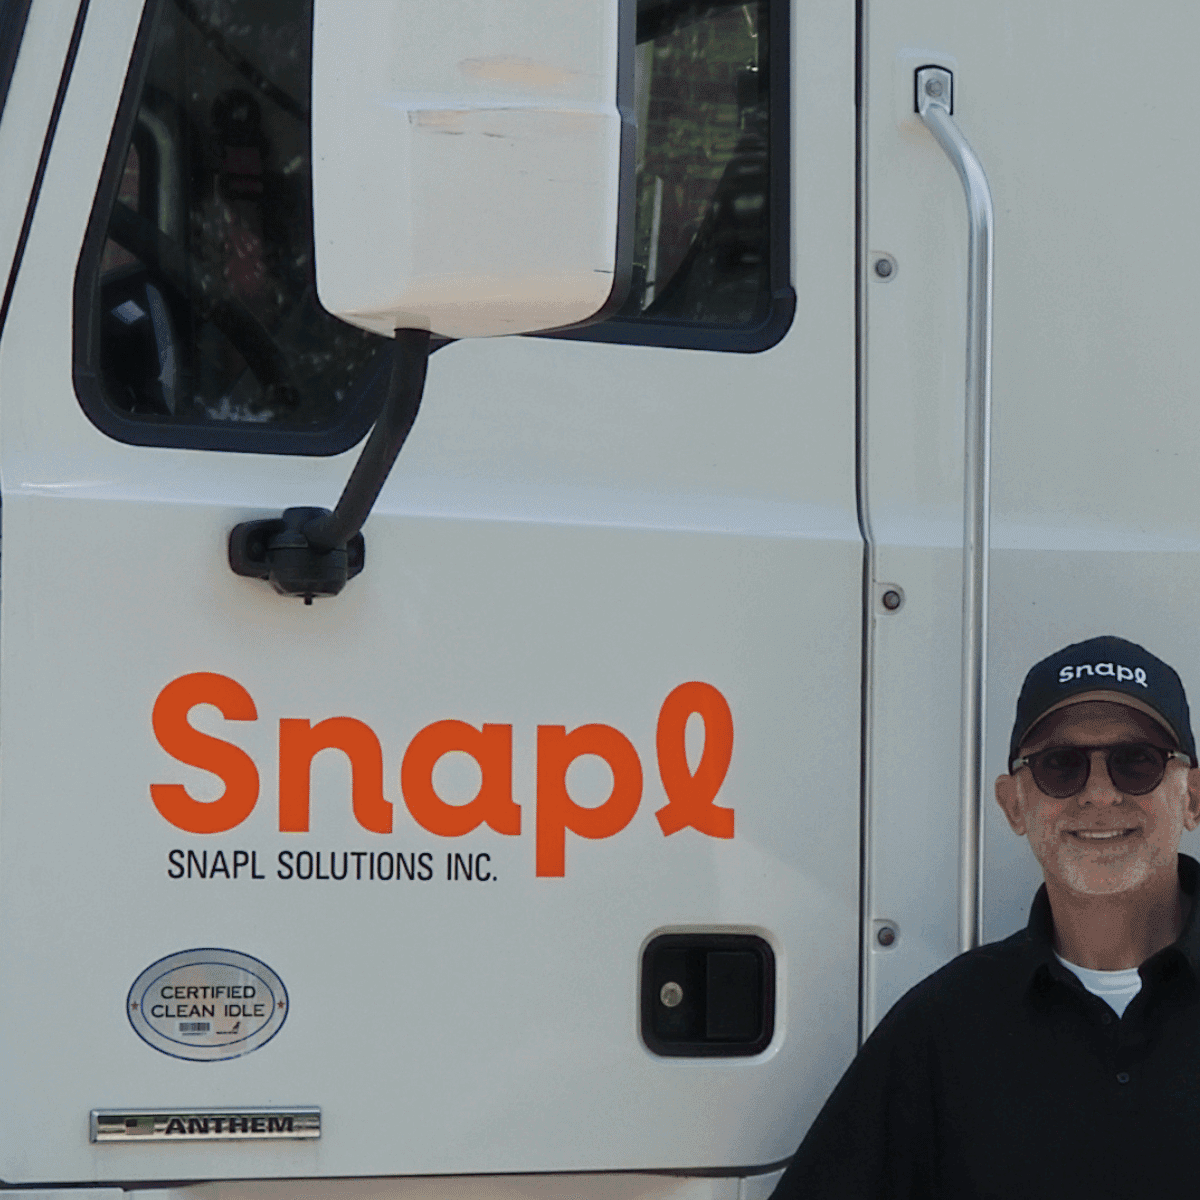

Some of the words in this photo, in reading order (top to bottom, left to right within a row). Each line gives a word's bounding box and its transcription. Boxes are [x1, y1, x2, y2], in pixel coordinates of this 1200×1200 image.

[149, 671, 735, 878] Snapl
[167, 848, 266, 880] SNAPL
[276, 850, 434, 882] SOLUTIONS
[446, 852, 498, 883] INC.
[160, 985, 257, 1000] CERTIFIED
[150, 1004, 215, 1018] CLEAN
[224, 1003, 266, 1017] IDLE
[164, 1116, 294, 1135] ANTHEM
